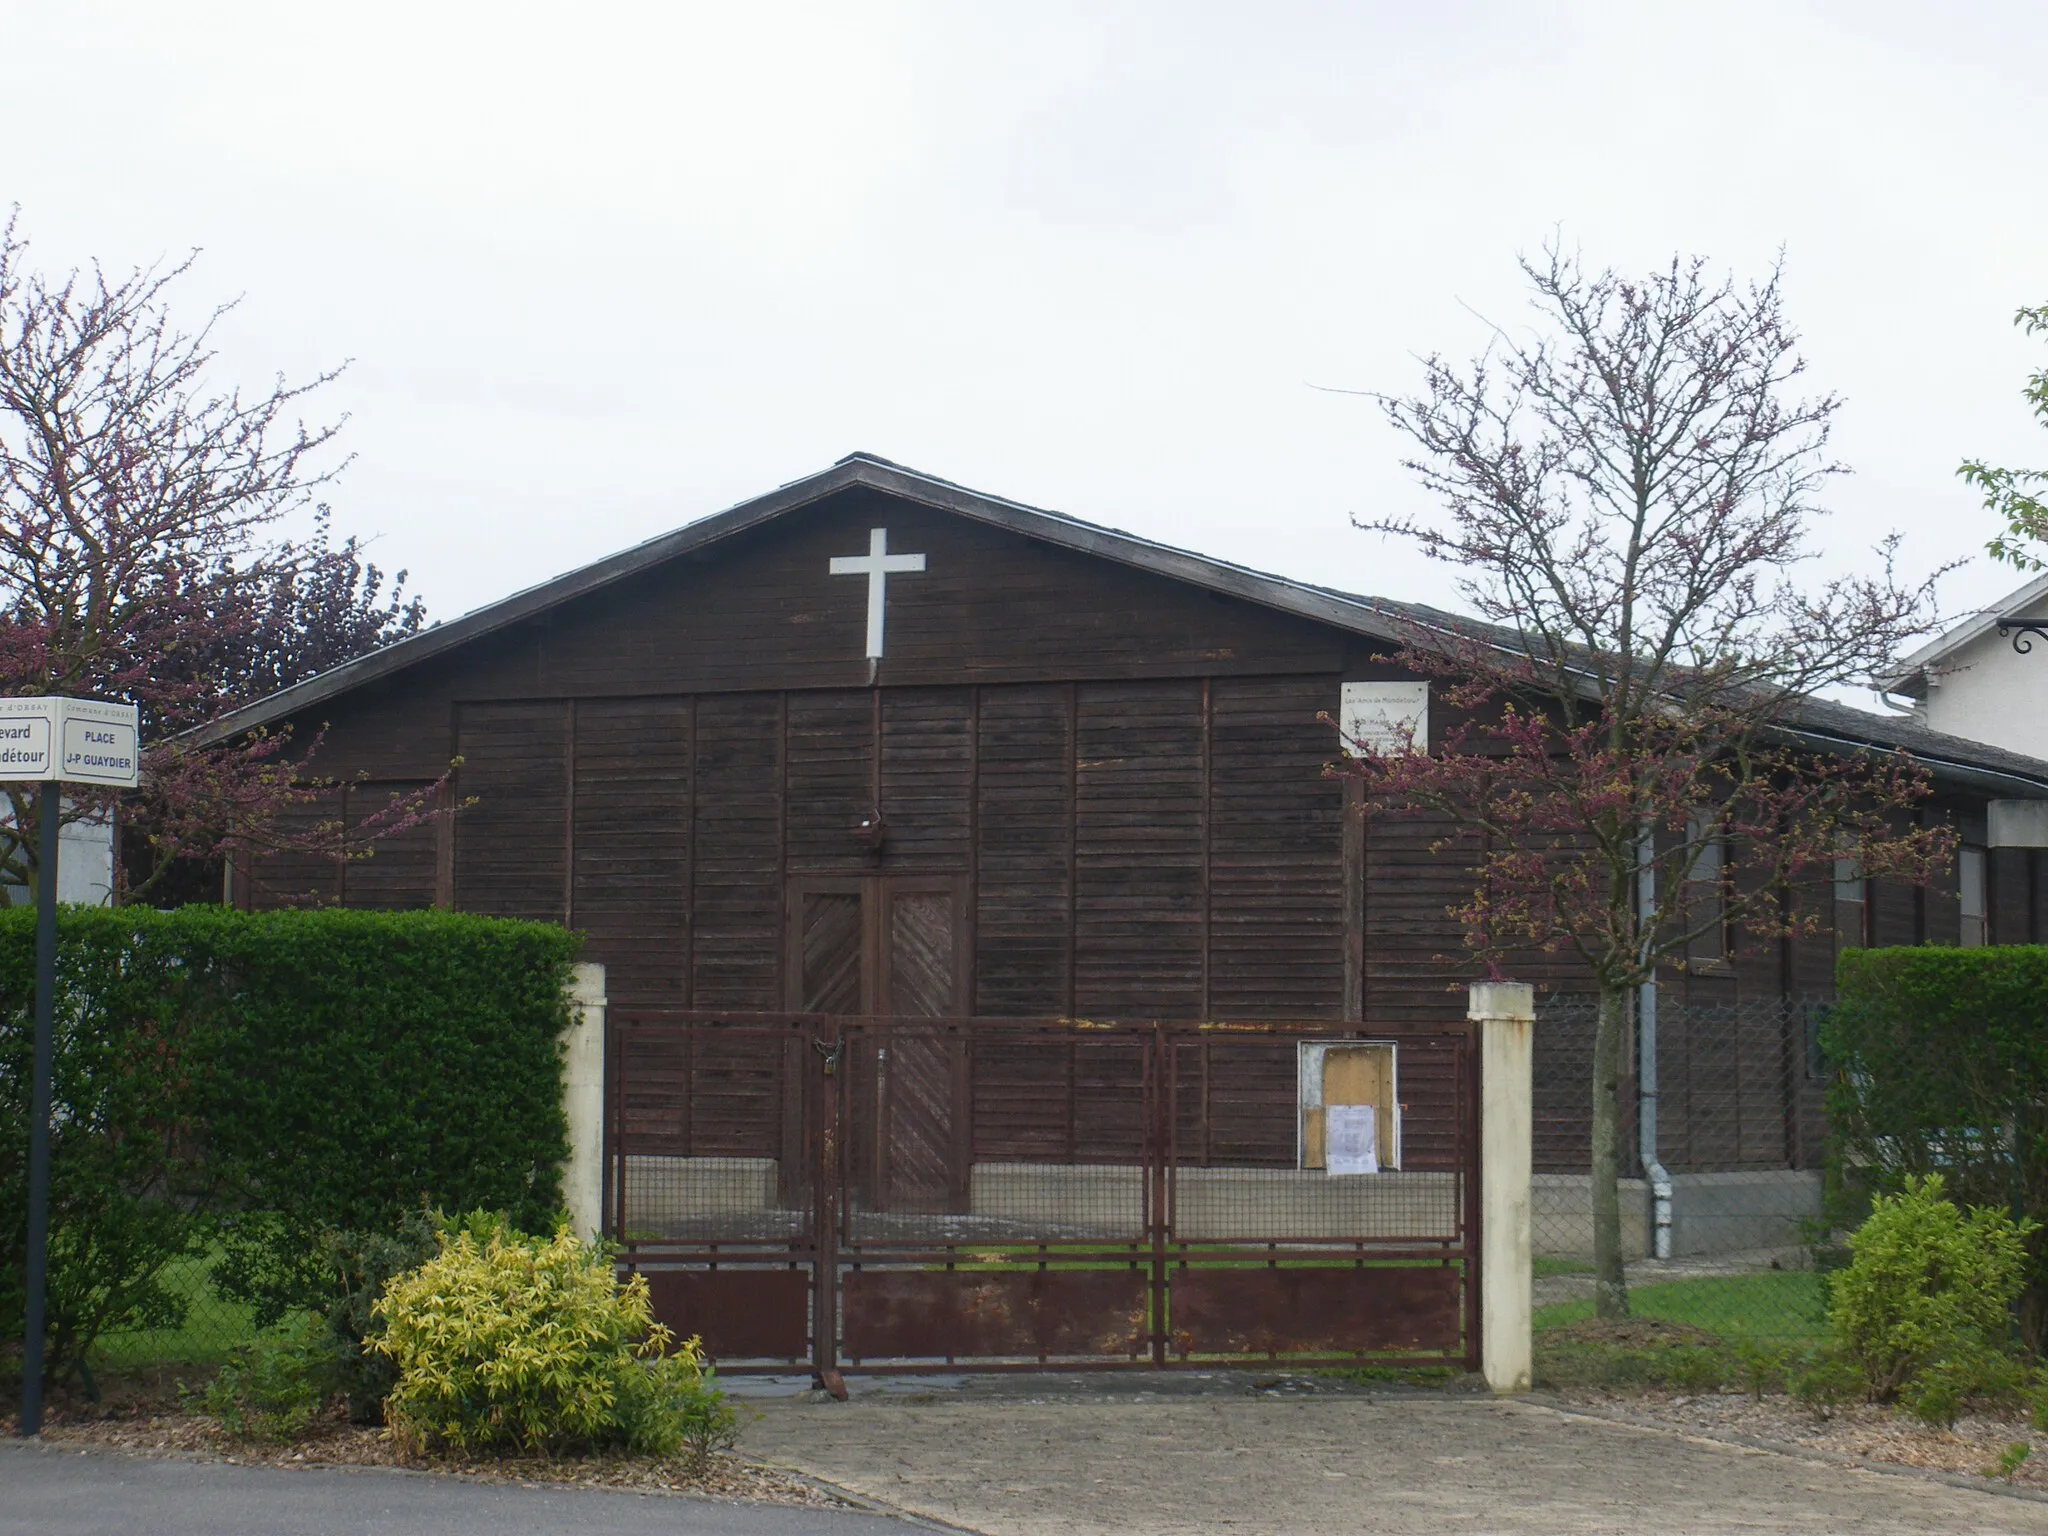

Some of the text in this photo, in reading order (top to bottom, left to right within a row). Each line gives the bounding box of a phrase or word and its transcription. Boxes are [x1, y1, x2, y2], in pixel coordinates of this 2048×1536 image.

[85, 731, 115, 744] PLACE
[67, 753, 131, 768] J-P GUAYDIER
